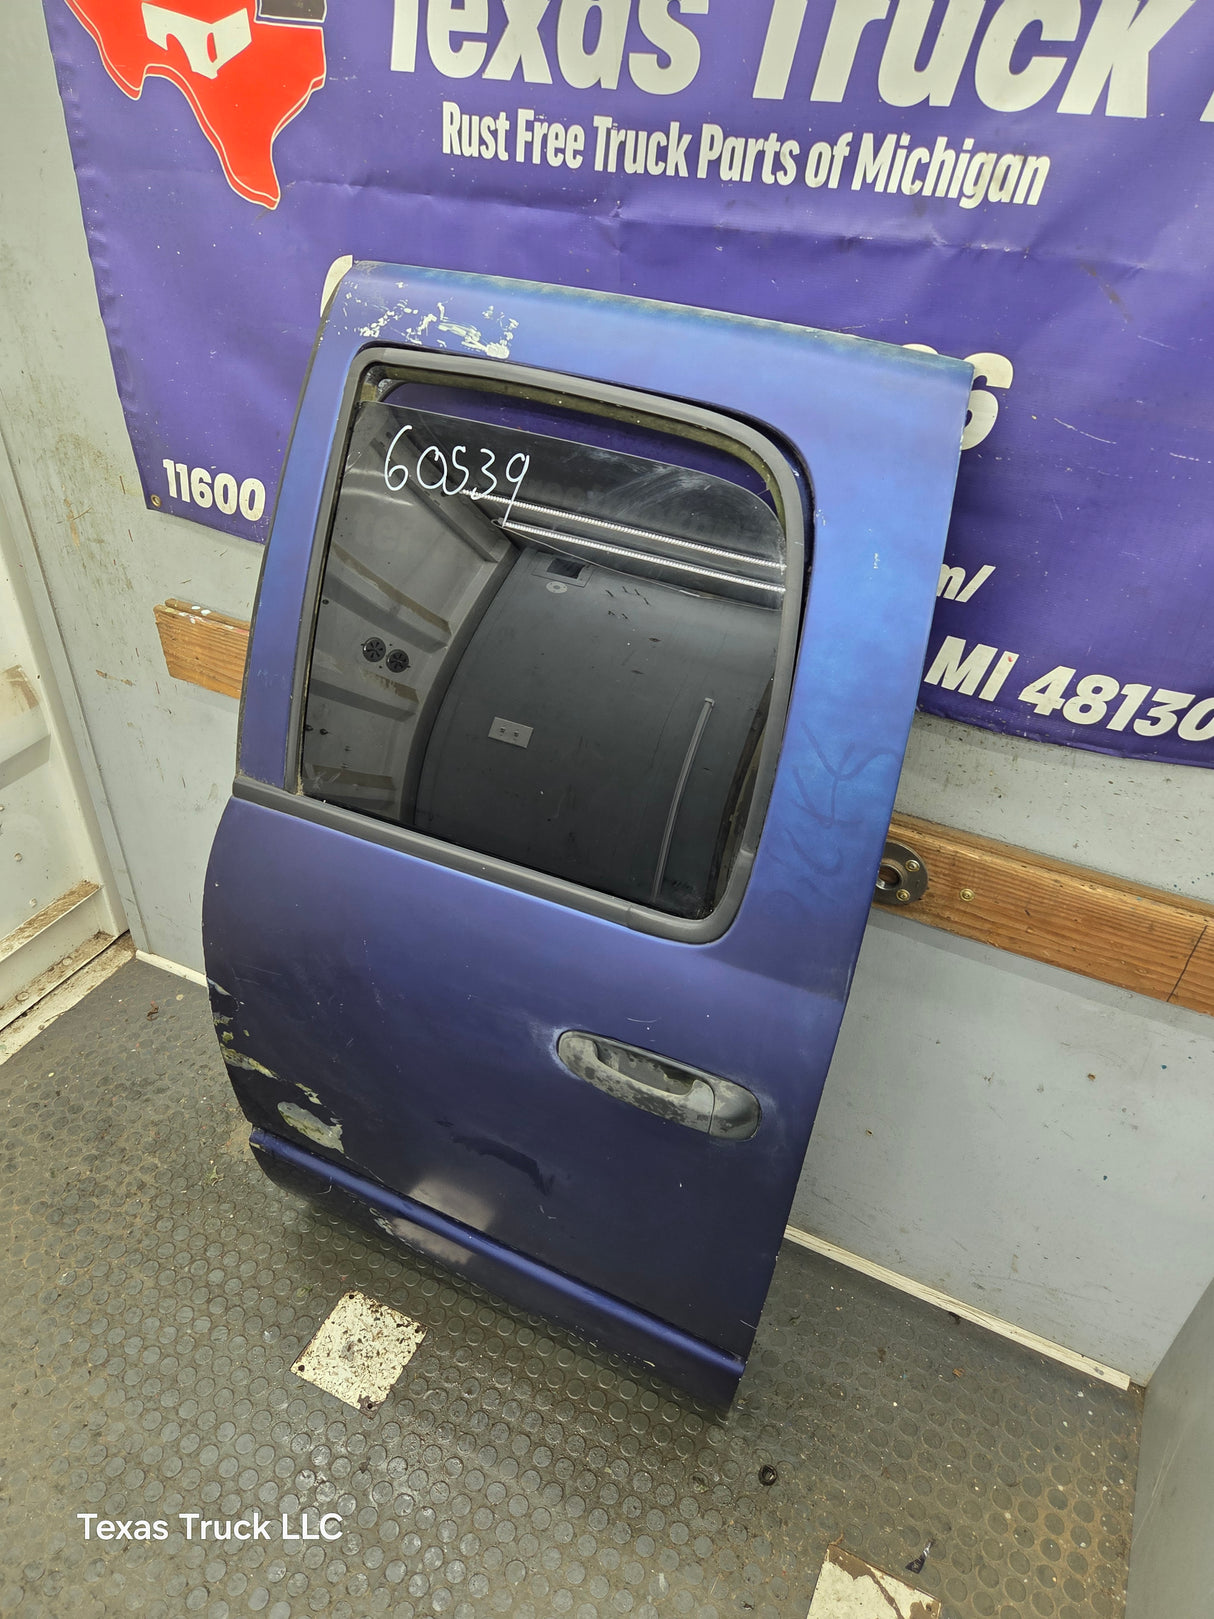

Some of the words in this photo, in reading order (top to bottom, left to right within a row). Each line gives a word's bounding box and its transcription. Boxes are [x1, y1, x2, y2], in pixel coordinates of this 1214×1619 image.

[441, 101, 509, 161] Rust
[515, 108, 584, 169] Free
[592, 115, 692, 178] Truck
[697, 123, 801, 187] Parts
[804, 131, 850, 189] of
[850, 132, 1051, 210] Michigan
[162, 458, 266, 521] 11600
[923, 635, 1019, 702] MI
[1017, 665, 1214, 742] 48130
